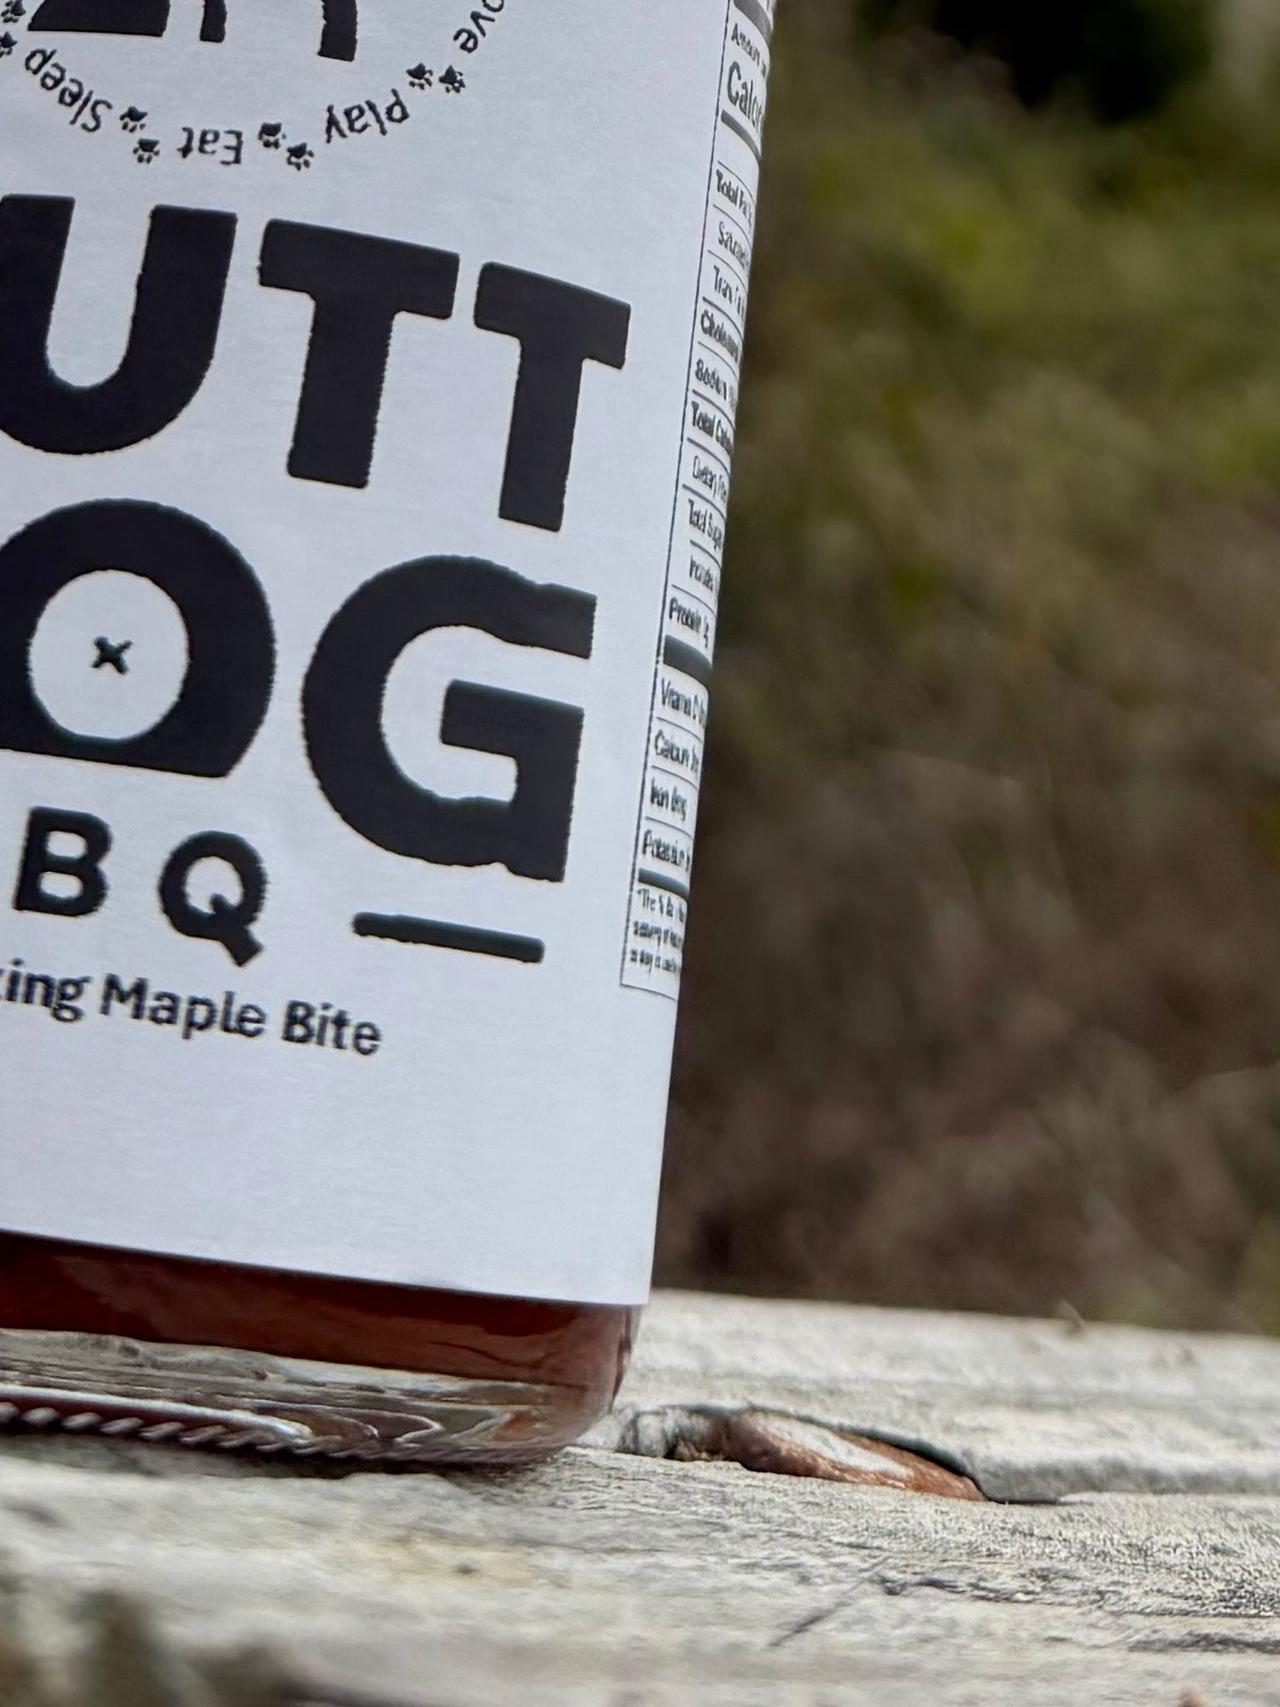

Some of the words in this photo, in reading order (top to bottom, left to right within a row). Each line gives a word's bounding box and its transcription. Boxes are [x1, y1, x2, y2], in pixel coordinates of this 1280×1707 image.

[24, 48, 113, 133] Sleep
[325, 88, 410, 145] Play
[176, 126, 244, 166] Eat
[99, 973, 266, 1040] Maple
[281, 1000, 381, 1056] Bite
